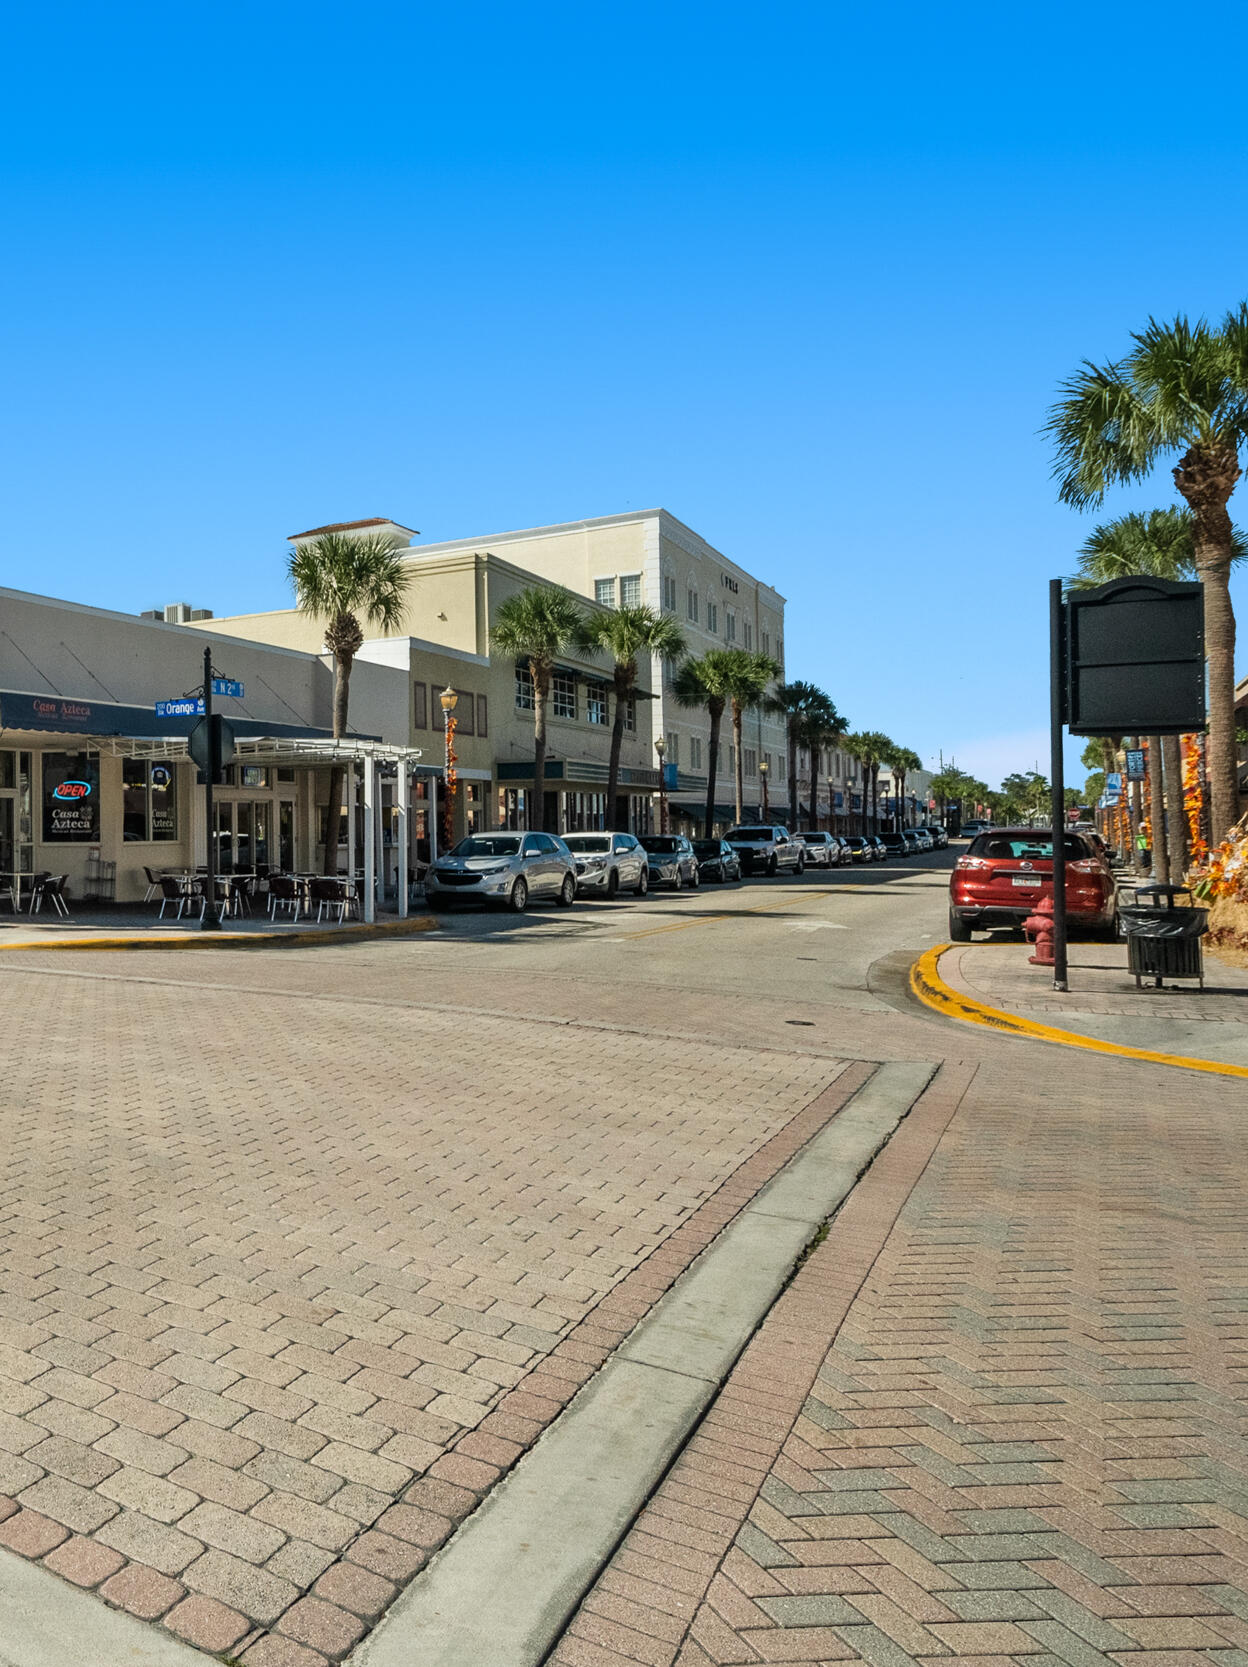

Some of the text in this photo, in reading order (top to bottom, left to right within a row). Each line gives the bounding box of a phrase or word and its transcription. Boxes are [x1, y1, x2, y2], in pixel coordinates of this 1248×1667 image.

[220, 682, 225, 693] N
[166, 703, 194, 715] Orange
[57, 784, 87, 797] OPEN
[52, 809, 79, 818] Casa
[51, 819, 91, 829] Azteca
